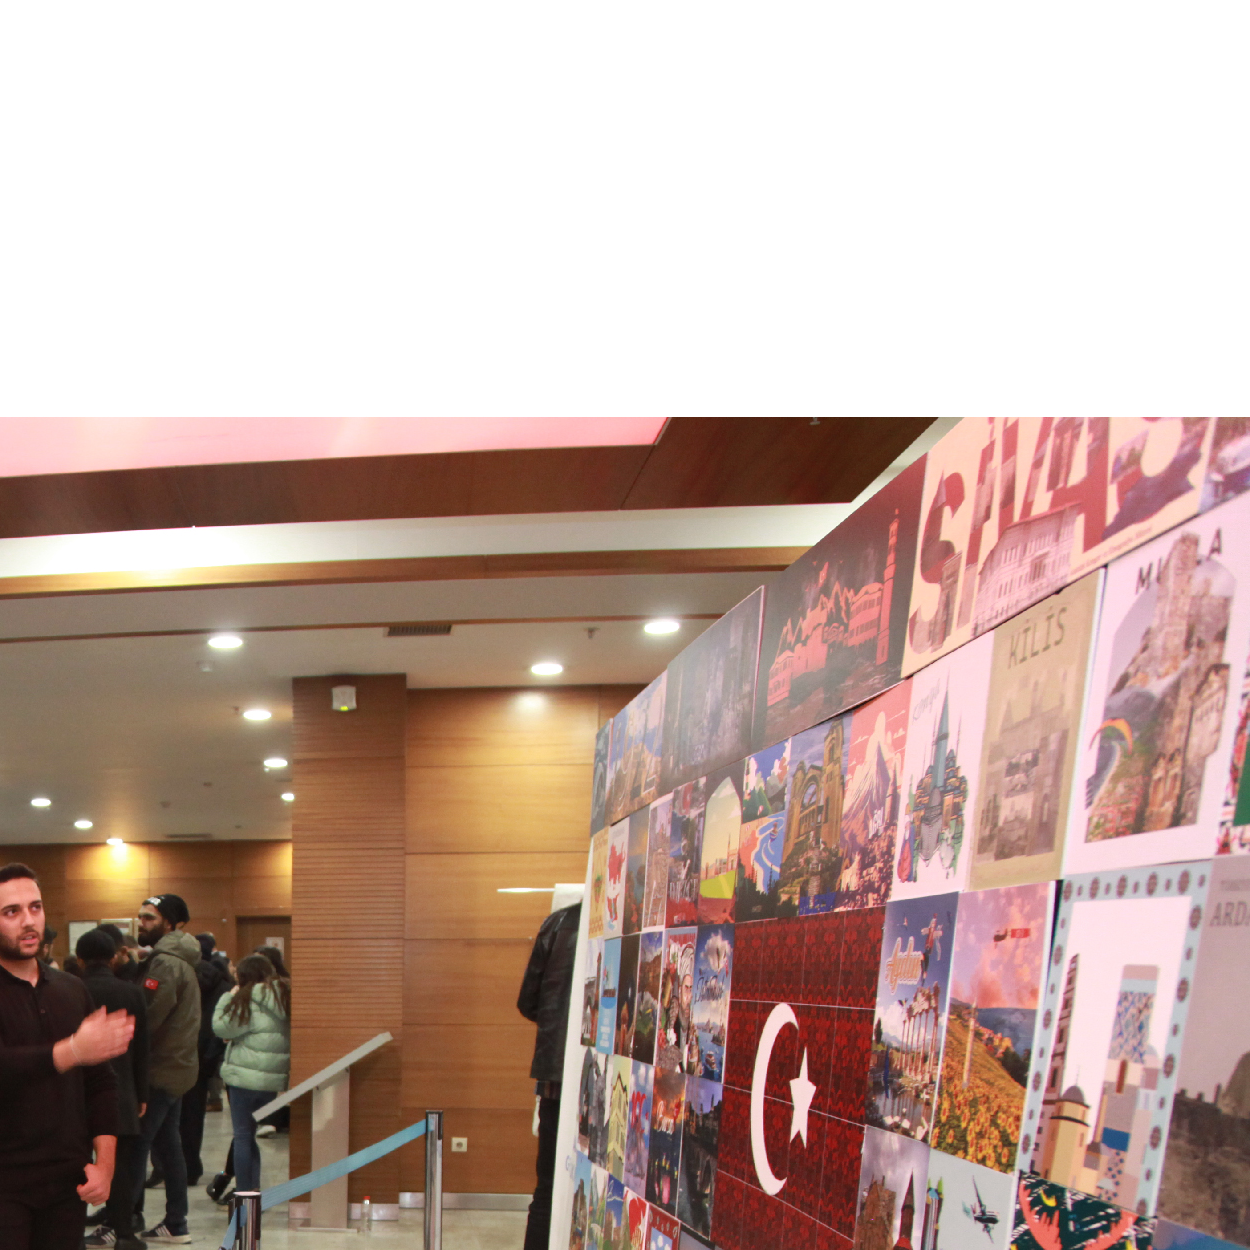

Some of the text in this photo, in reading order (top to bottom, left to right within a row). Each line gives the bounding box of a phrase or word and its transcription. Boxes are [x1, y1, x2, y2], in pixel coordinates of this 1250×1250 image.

[1135, 526, 1222, 595] MUA
[1007, 605, 1067, 669] KİLİS
[1210, 901, 1250, 927] ARD
